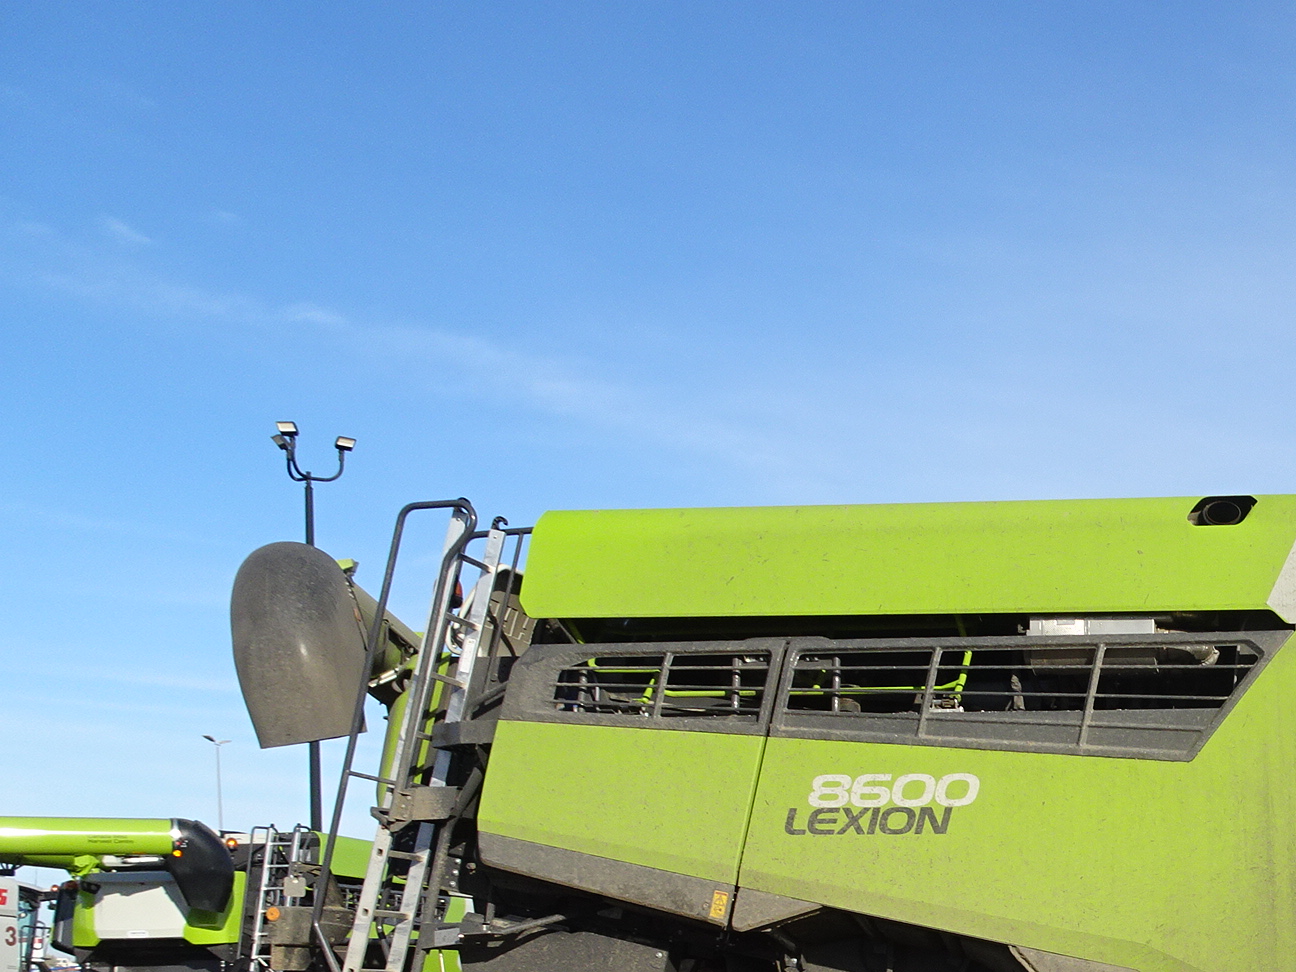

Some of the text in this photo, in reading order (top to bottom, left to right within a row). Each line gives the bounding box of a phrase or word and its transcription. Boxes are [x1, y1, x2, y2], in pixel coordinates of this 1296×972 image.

[808, 773, 980, 807] 8600
[784, 806, 953, 836] LEXION
[5, 926, 17, 946] 3
